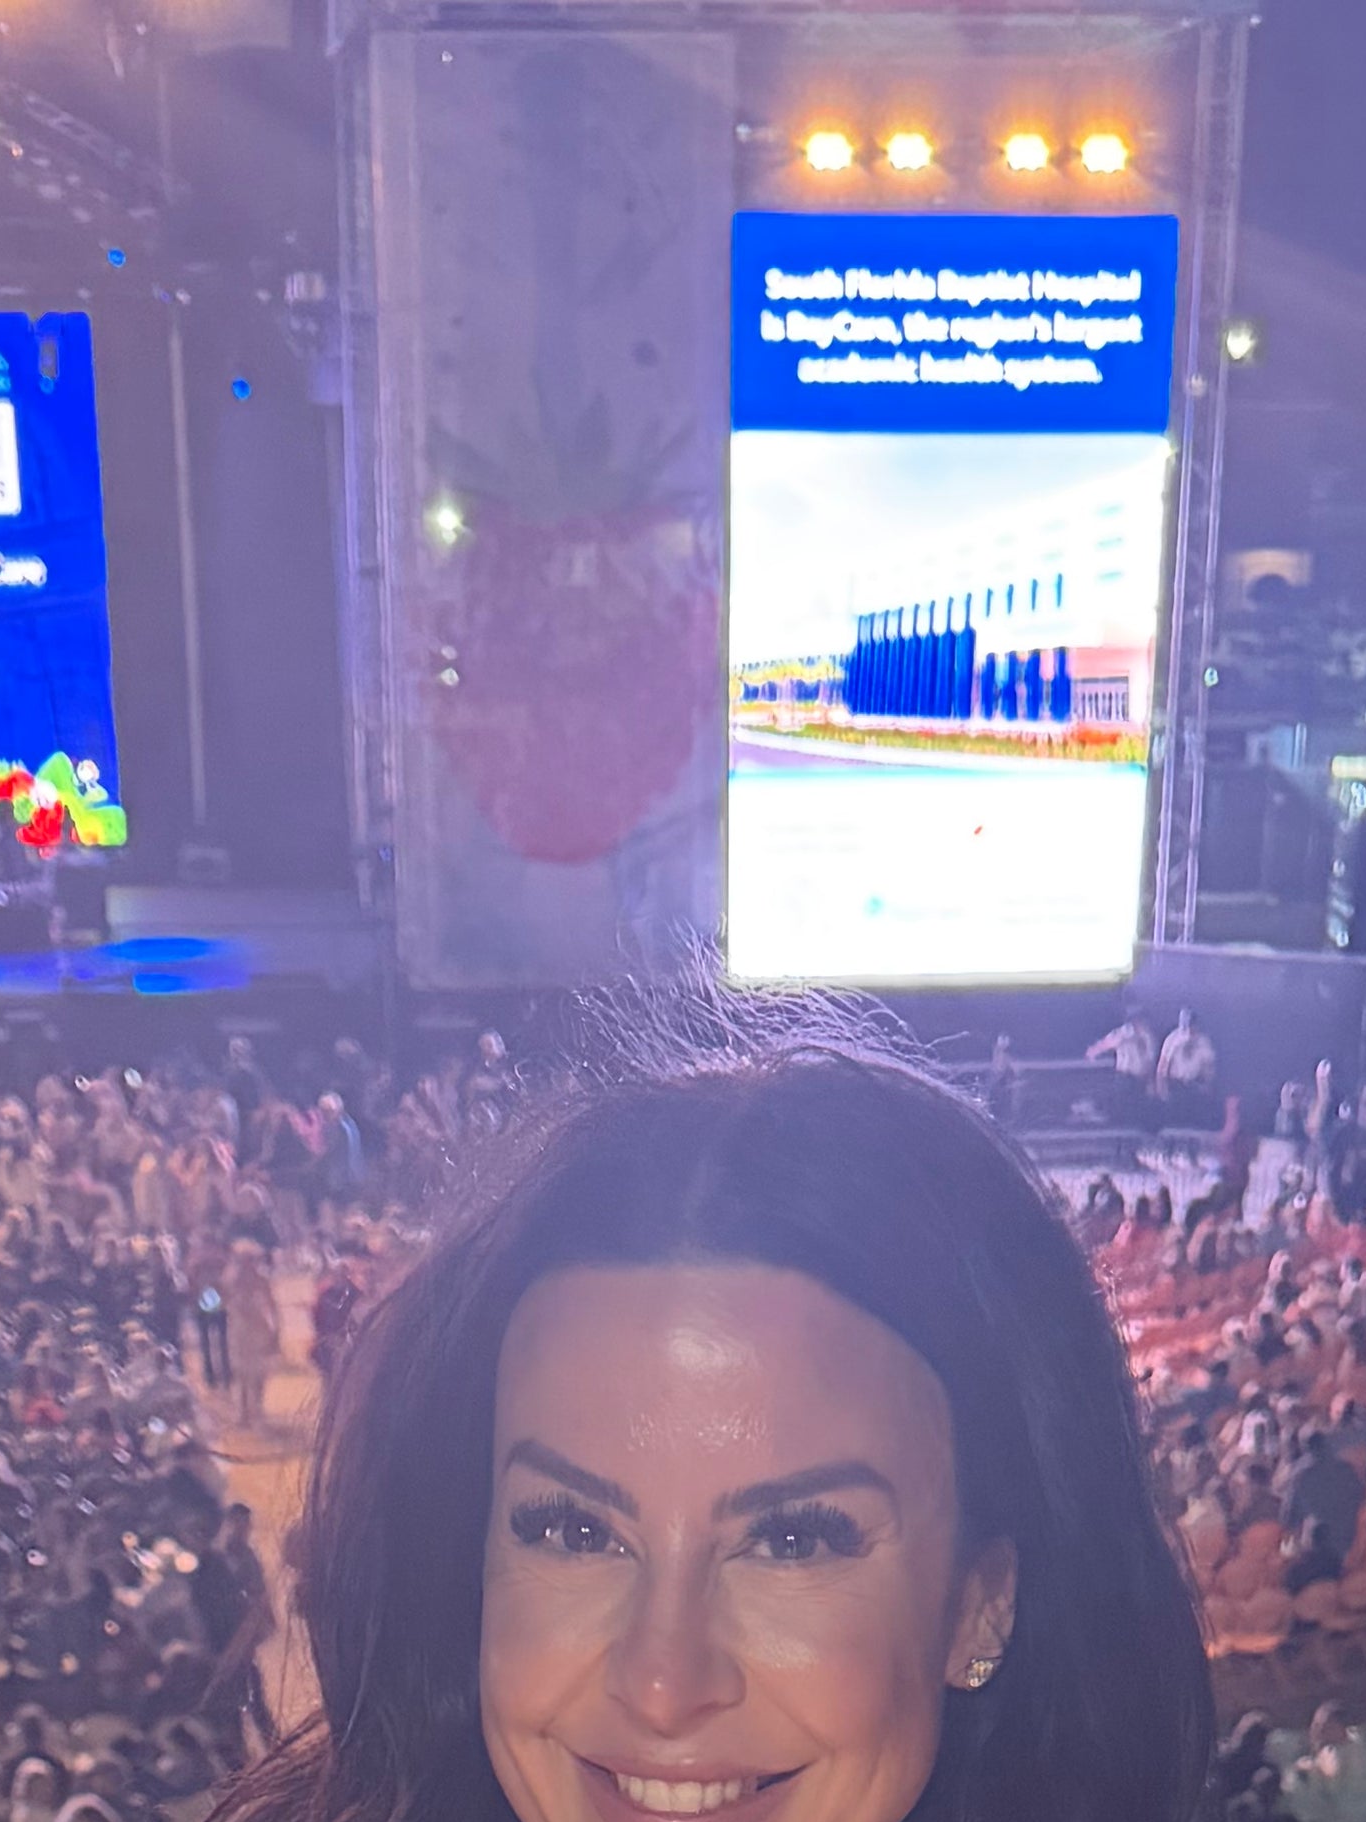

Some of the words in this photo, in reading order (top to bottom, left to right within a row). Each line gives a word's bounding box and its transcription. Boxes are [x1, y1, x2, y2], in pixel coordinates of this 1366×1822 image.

[765, 268, 843, 300] South
[844, 268, 936, 300] Florida
[937, 268, 1031, 307] Baptist
[1032, 268, 1141, 308] Hospital
